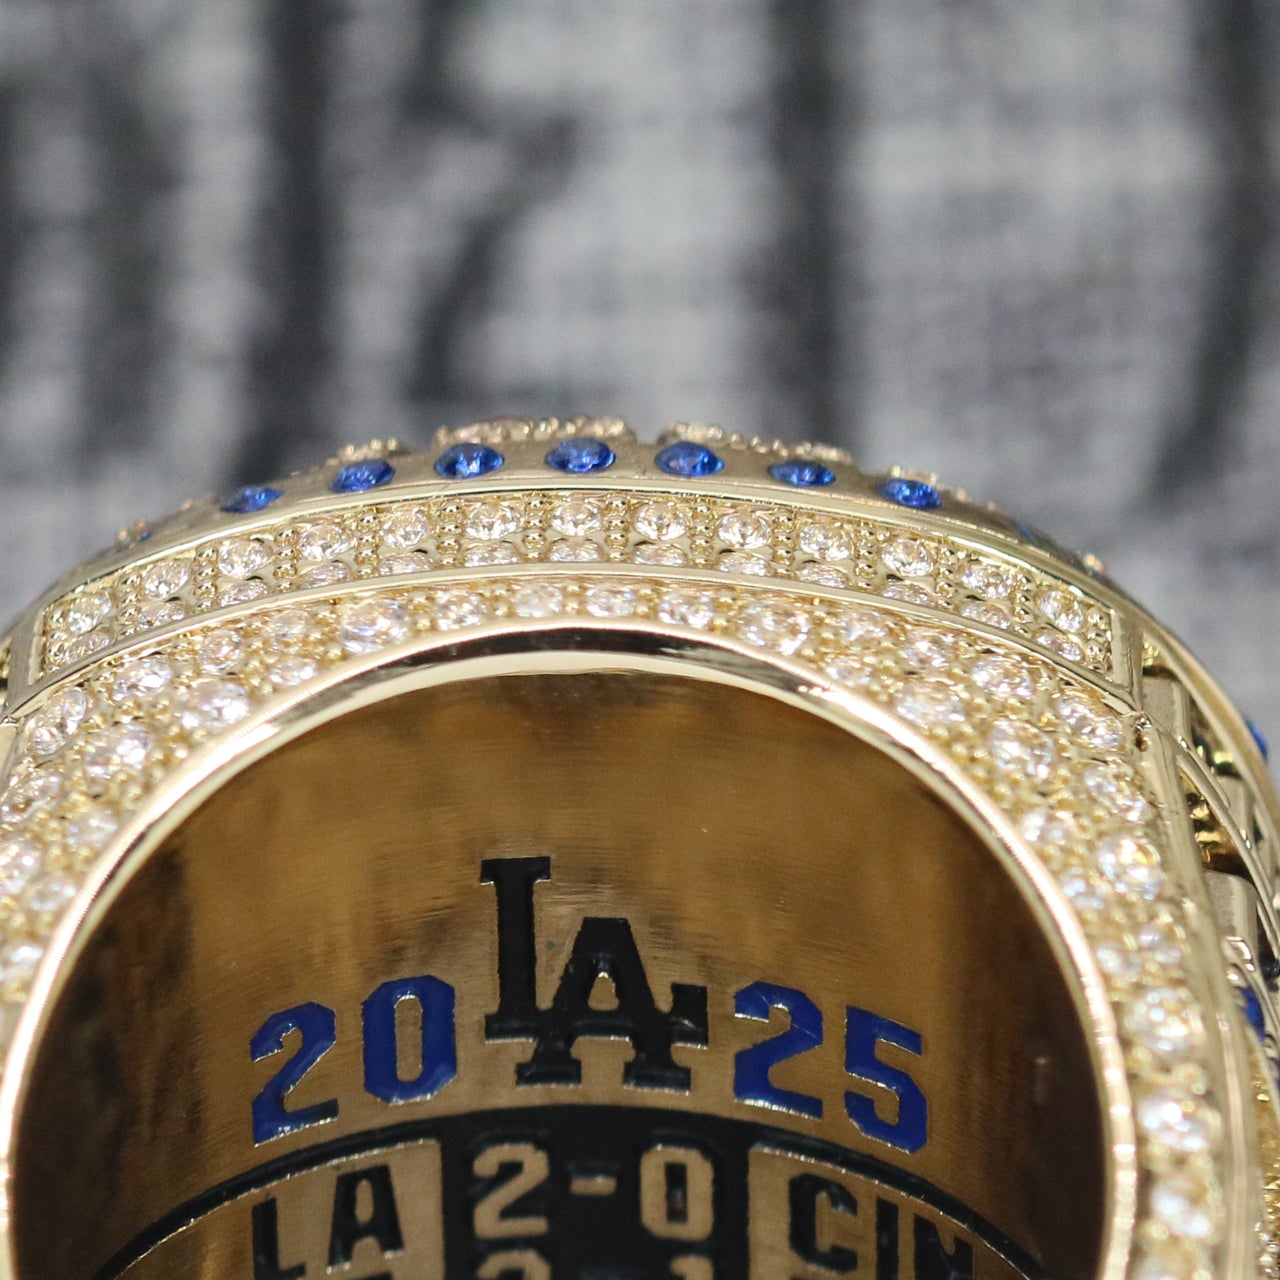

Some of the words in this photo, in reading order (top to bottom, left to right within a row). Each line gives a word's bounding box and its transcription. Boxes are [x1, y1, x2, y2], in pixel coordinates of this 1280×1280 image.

[250, 975, 458, 1147] 20
[480, 856, 709, 1092] LA
[733, 980, 928, 1154] 25
[473, 1142, 715, 1241] 2-0
